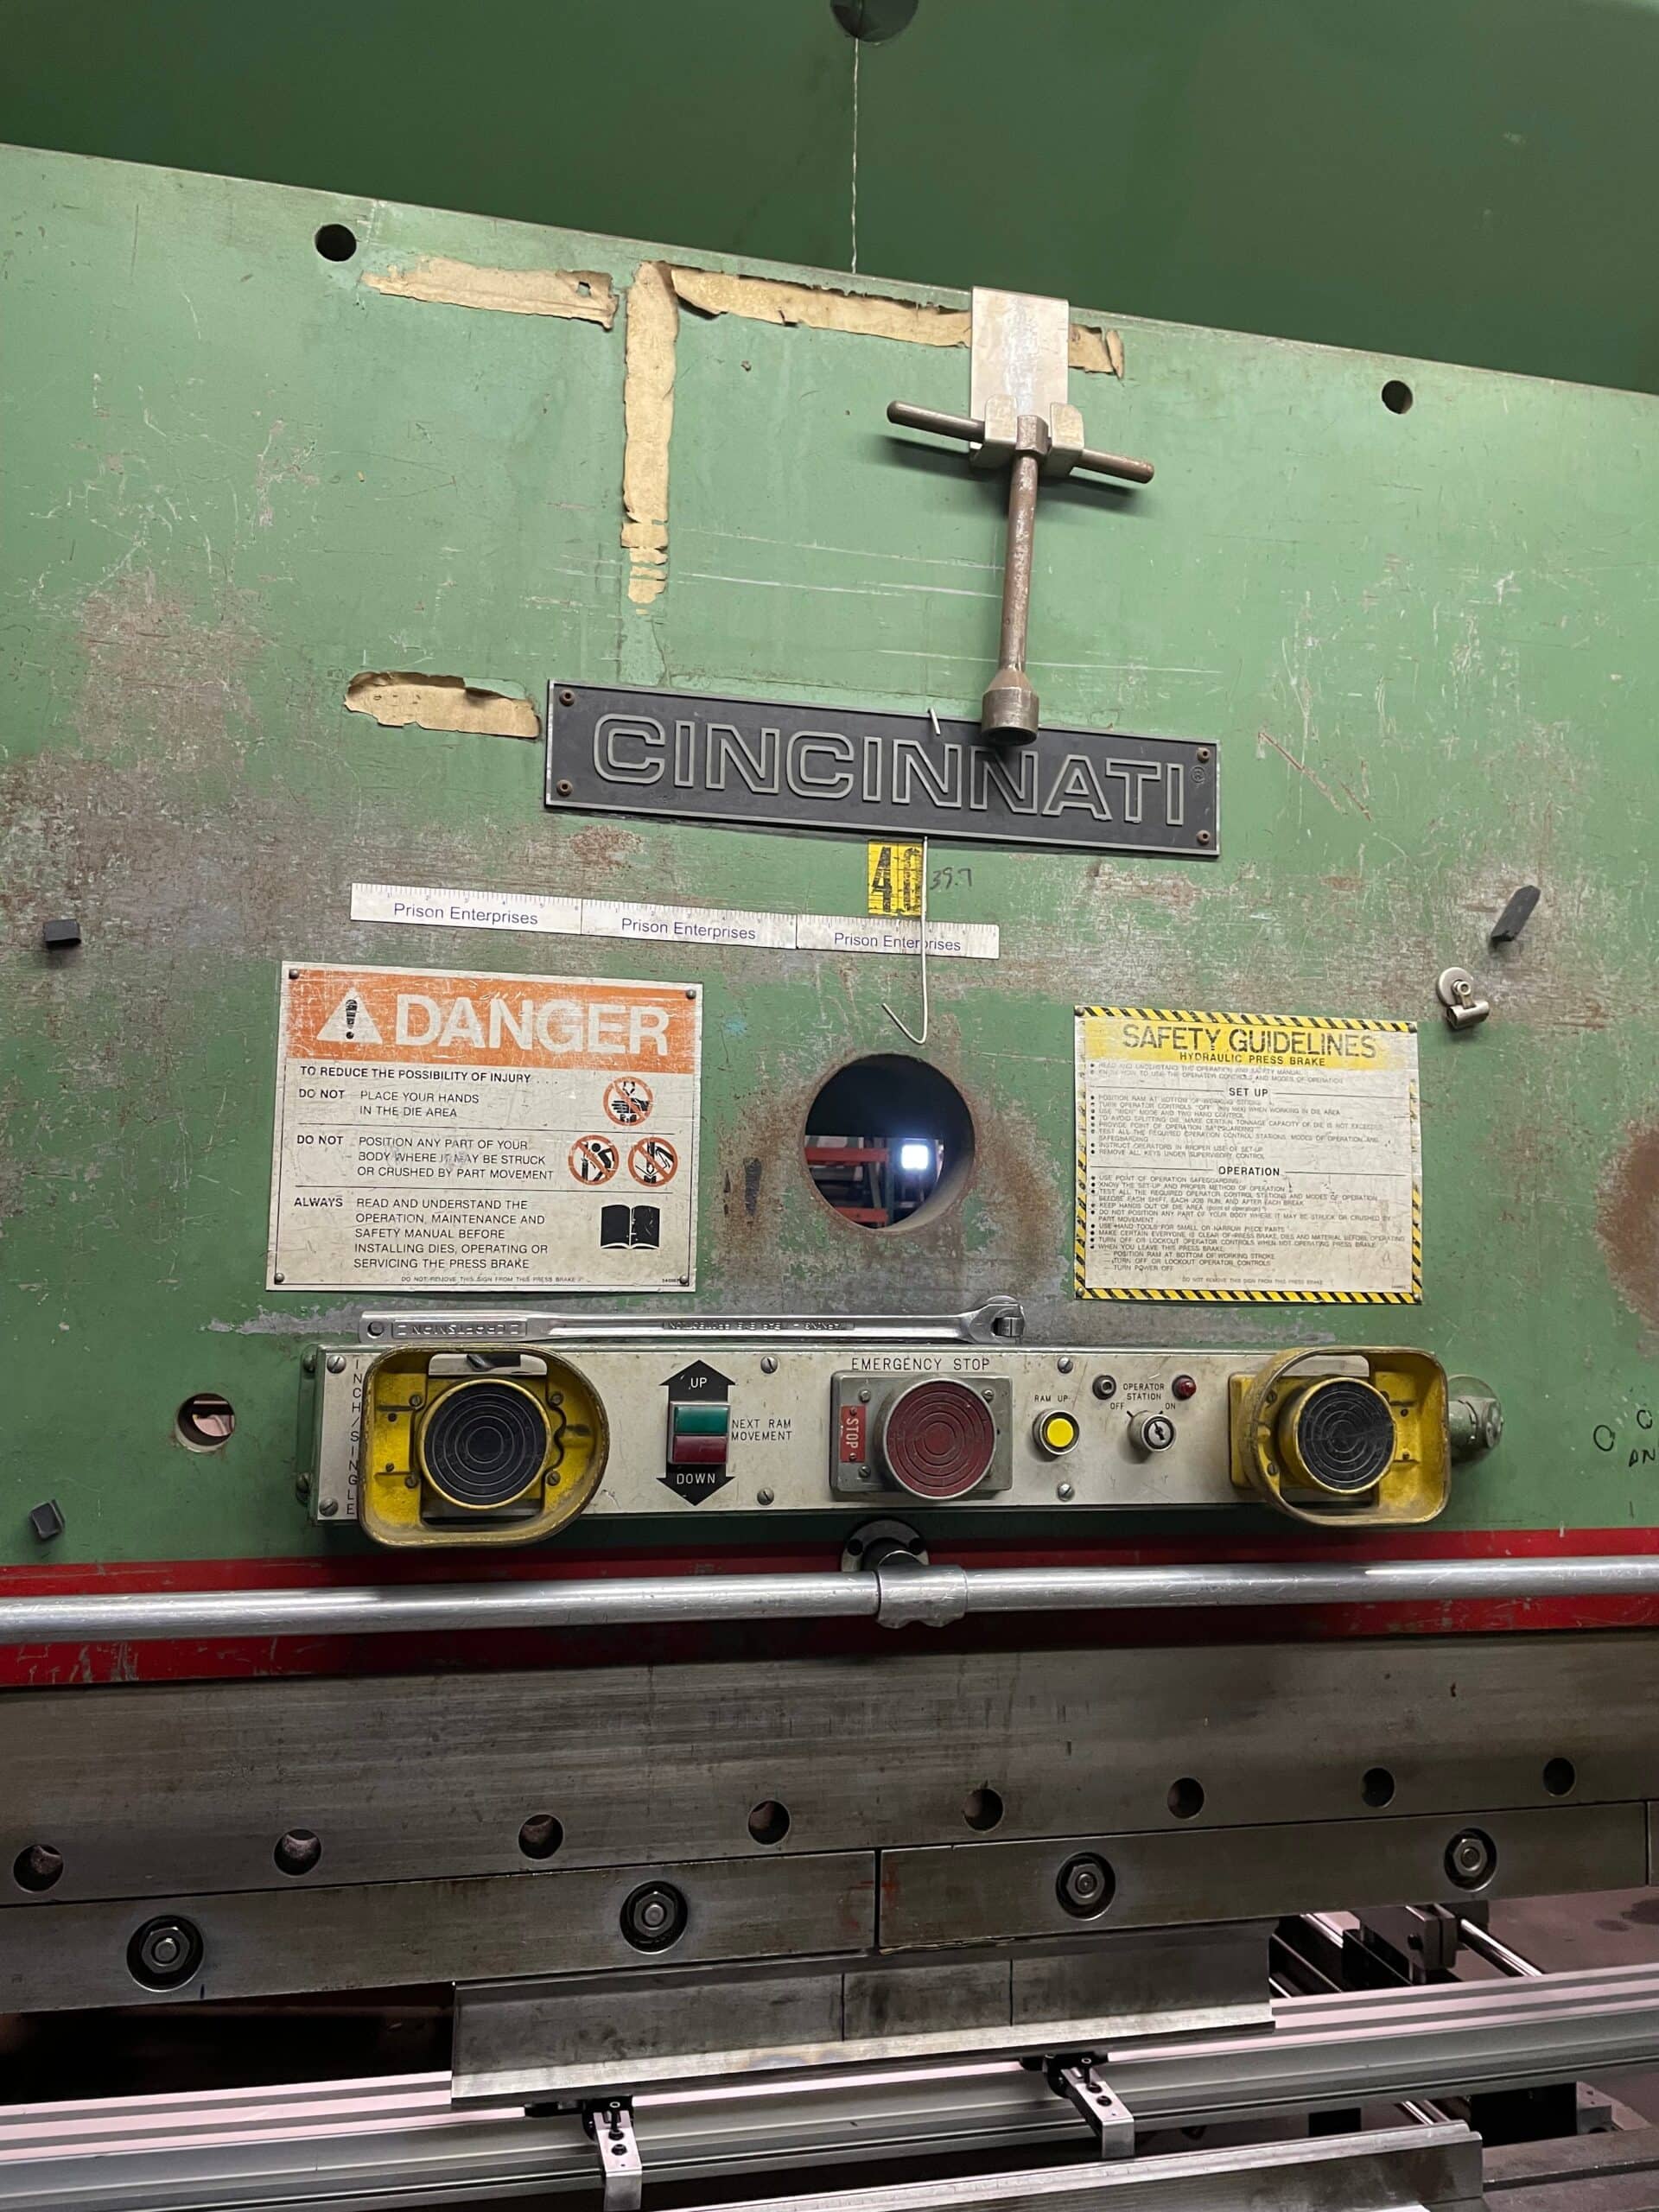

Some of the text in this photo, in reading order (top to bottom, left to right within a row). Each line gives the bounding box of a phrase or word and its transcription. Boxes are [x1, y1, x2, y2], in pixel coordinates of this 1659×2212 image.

[594, 712, 1183, 826] CINCINNATI
[394, 903, 537, 925] Prison Enterprises
[622, 918, 755, 939] Prison Enterprises
[835, 933, 878, 947] Prison
[396, 994, 668, 1056] DANGER
[1122, 1024, 1376, 1058] SAFETY GUIDELINES
[1179, 1051, 1325, 1066] HYDRAULIC PRESS BRAKE
[300, 1066, 531, 1083] TO REDUCE THE POSSIBILITY OF INJURY
[299, 1089, 345, 1098] DO NOT
[360, 1090, 479, 1103] PLACE YOUR HANDS
[1229, 1087, 1268, 1096] SET UP
[360, 1105, 456, 1117] IN THE DIE AREA
[297, 1135, 343, 1144] DO NOT
[359, 1136, 526, 1149] POSITION ANY PART OF YOUR
[359, 1151, 390, 1160] BODY
[394, 1152, 436, 1162] WHERE
[483, 1154, 497, 1163] BE
[501, 1155, 545, 1165] STRUCK
[357, 1166, 553, 1179] OR CRUSHED BY PART MOVEMENT
[1218, 1166, 1280, 1176] OPERATION
[294, 1197, 343, 1206] ALWAYS
[356, 1198, 527, 1210] READ AND UNDERSTAND THE
[431, 1214, 516, 1224] MAINTENANCE
[520, 1216, 544, 1224] AND
[355, 1228, 505, 1239] SAFETY MANUAL BEFORE
[354, 1243, 547, 1254] INSTALLING DIES, OPERATING OR
[353, 1258, 529, 1268] SERVICING THE PRESS BRAKE
[851, 1358, 989, 1371] EMERGENCY STOP
[691, 1377, 707, 1389] UP
[732, 1419, 791, 1428] NEXT RAM
[732, 1430, 793, 1441] MOVEMENT
[846, 1418, 859, 1448] STOP
[676, 1473, 716, 1485] DOWN
